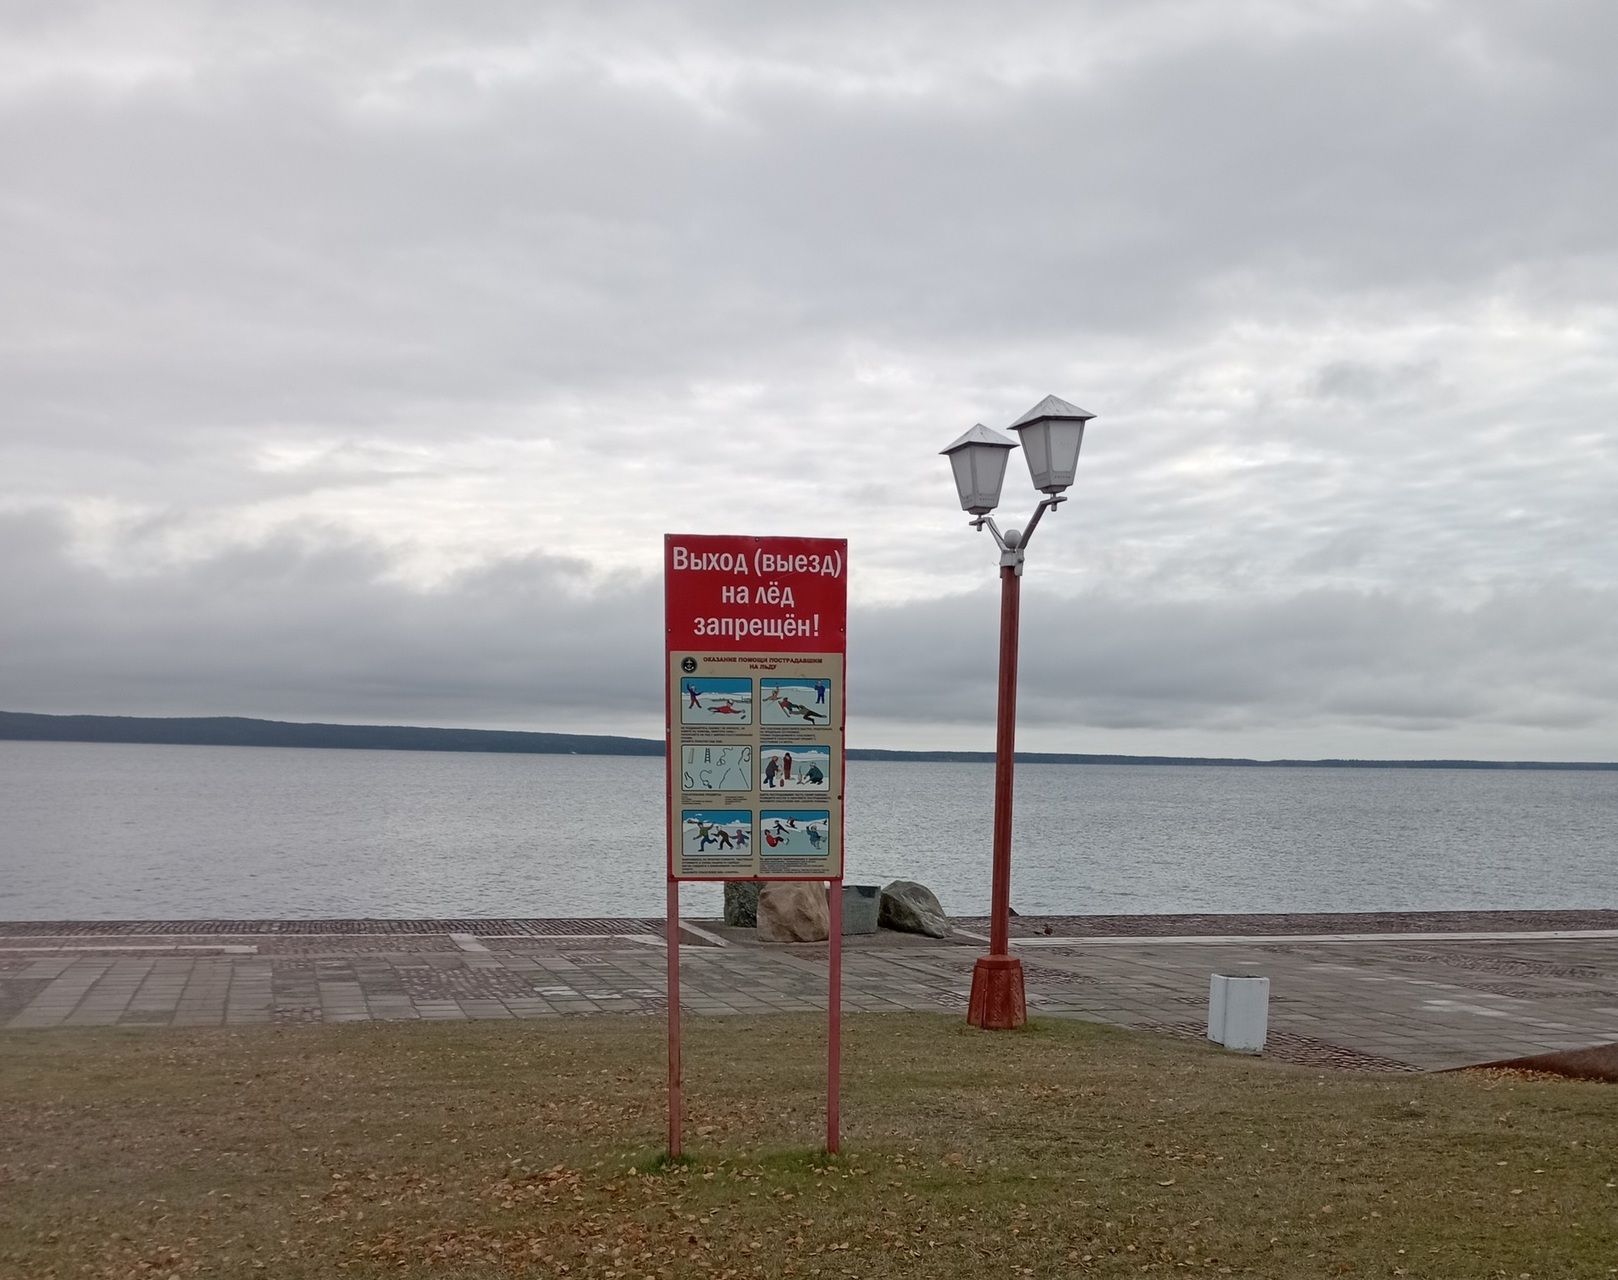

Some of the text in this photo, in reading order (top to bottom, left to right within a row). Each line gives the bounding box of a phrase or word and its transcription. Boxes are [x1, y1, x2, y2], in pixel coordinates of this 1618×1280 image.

[673, 546, 842, 578] Выход (выезд)
[721, 581, 795, 608] на лёд
[693, 613, 819, 641] запрещён!
